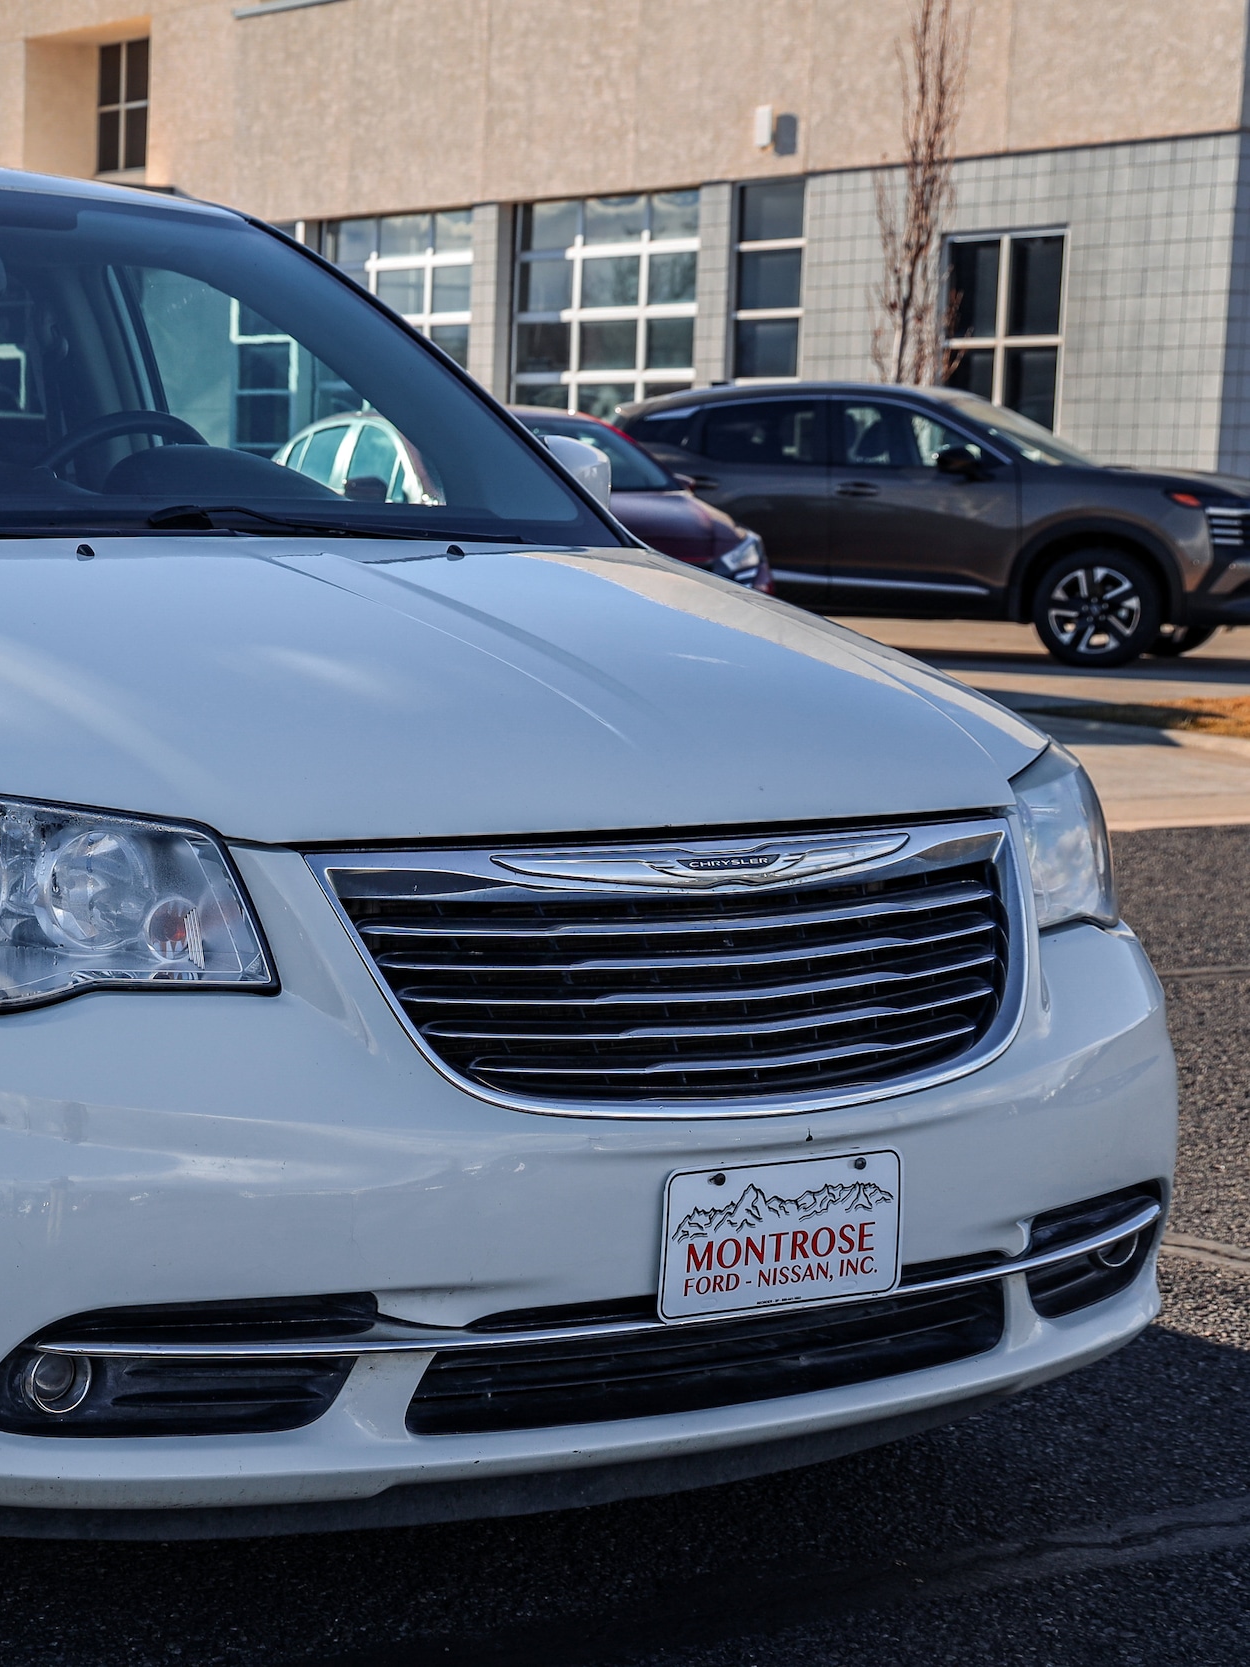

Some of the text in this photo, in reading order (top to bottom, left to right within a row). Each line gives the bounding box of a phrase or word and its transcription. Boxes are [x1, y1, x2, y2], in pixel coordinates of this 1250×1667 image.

[689, 858, 768, 868] CHRYSLER
[686, 1222, 876, 1273] MONTROSE
[683, 1273, 740, 1297] FORD
[757, 1261, 834, 1288] NISSAN,
[839, 1256, 878, 1278] INC.
